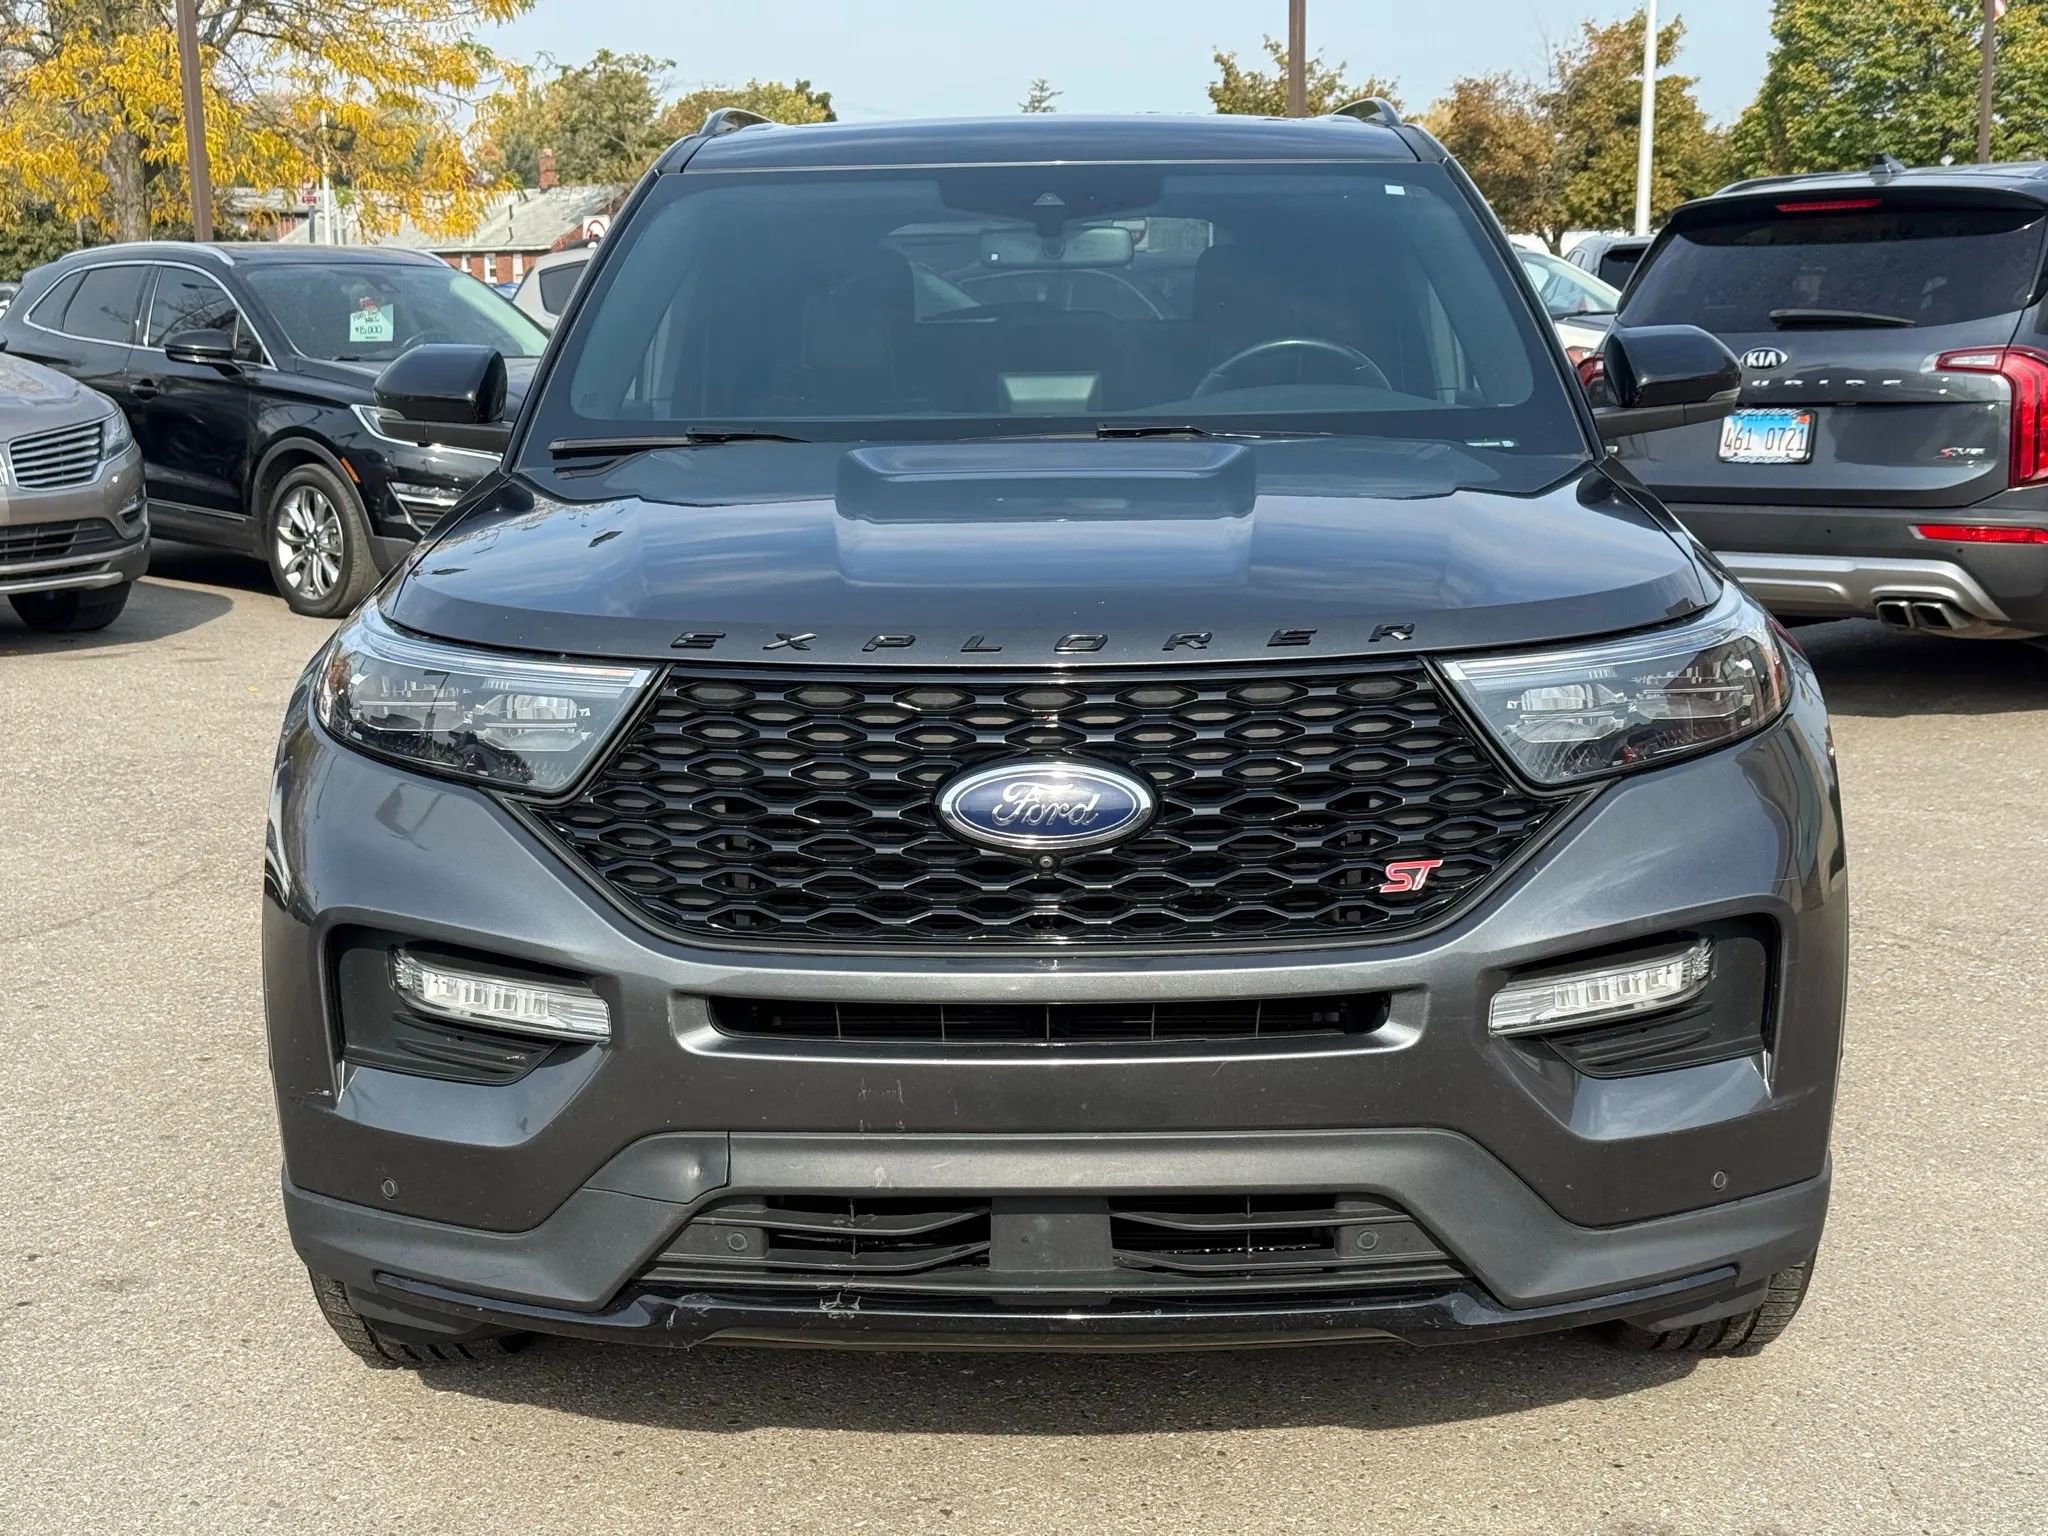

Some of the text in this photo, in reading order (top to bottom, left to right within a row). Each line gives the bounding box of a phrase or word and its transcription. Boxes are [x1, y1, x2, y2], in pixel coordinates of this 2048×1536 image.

[1747, 350, 1777, 367] KIA
[1723, 427, 1806, 452] 461 0721
[671, 622, 1414, 653] EXPLORER
[991, 781, 1101, 827] Ford
[1379, 859, 1444, 893] ST
